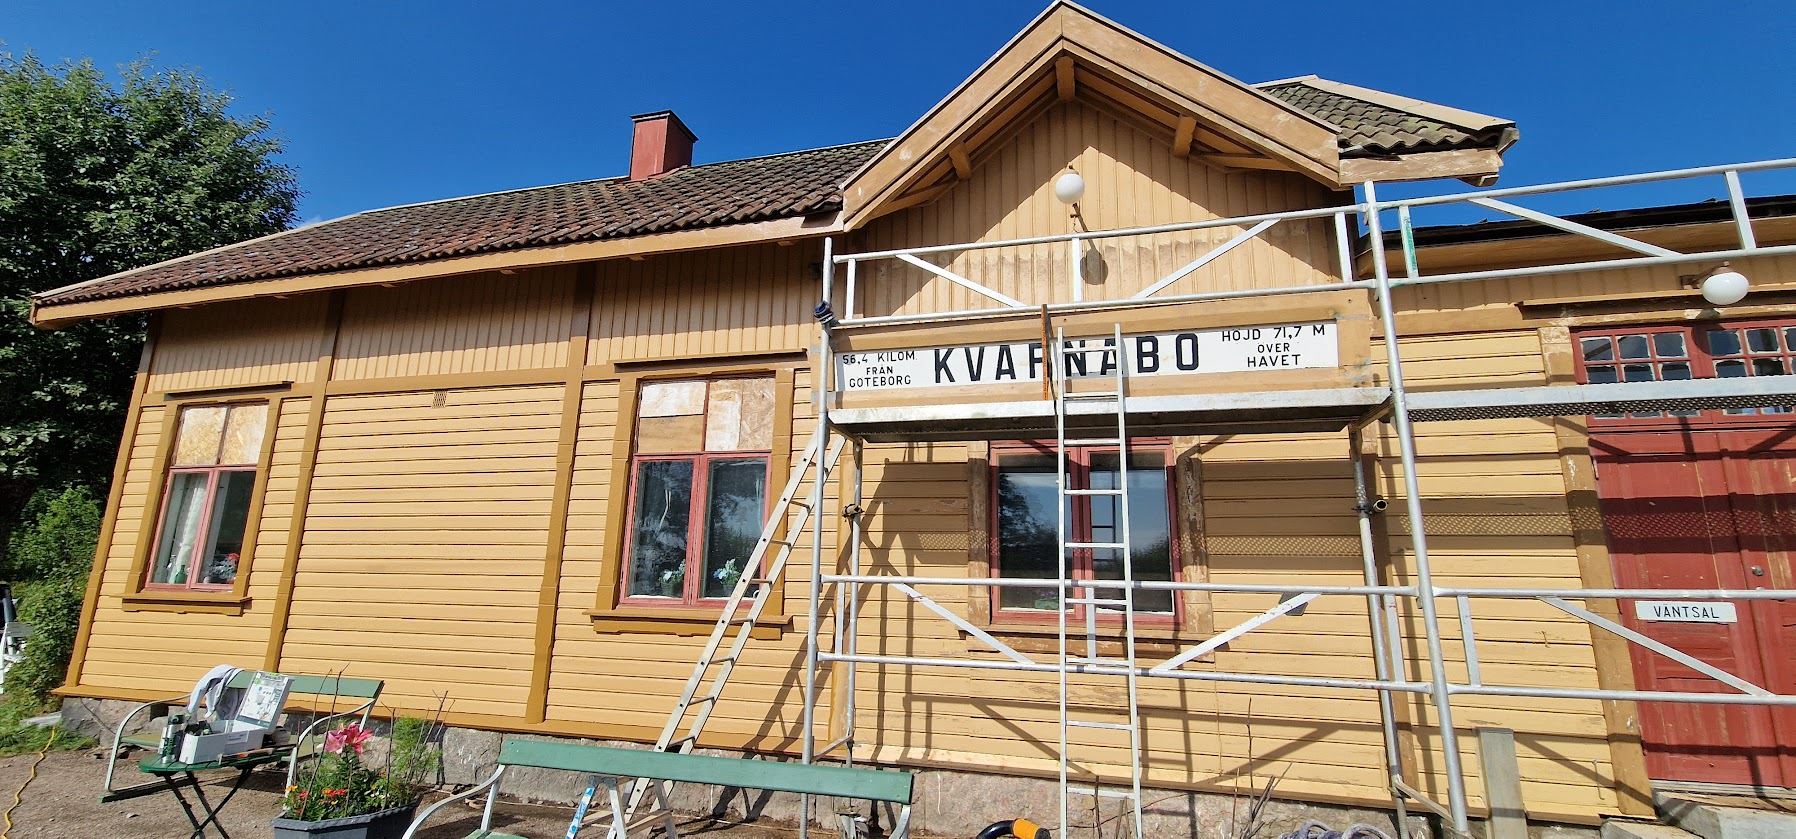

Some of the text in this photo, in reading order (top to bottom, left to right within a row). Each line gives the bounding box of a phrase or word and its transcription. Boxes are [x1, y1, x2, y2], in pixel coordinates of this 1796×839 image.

[1273, 326, 1302, 340] 71,7
[1312, 324, 1325, 337] M
[842, 353, 868, 365] 56,4
[1247, 353, 1302, 368] HAVET
